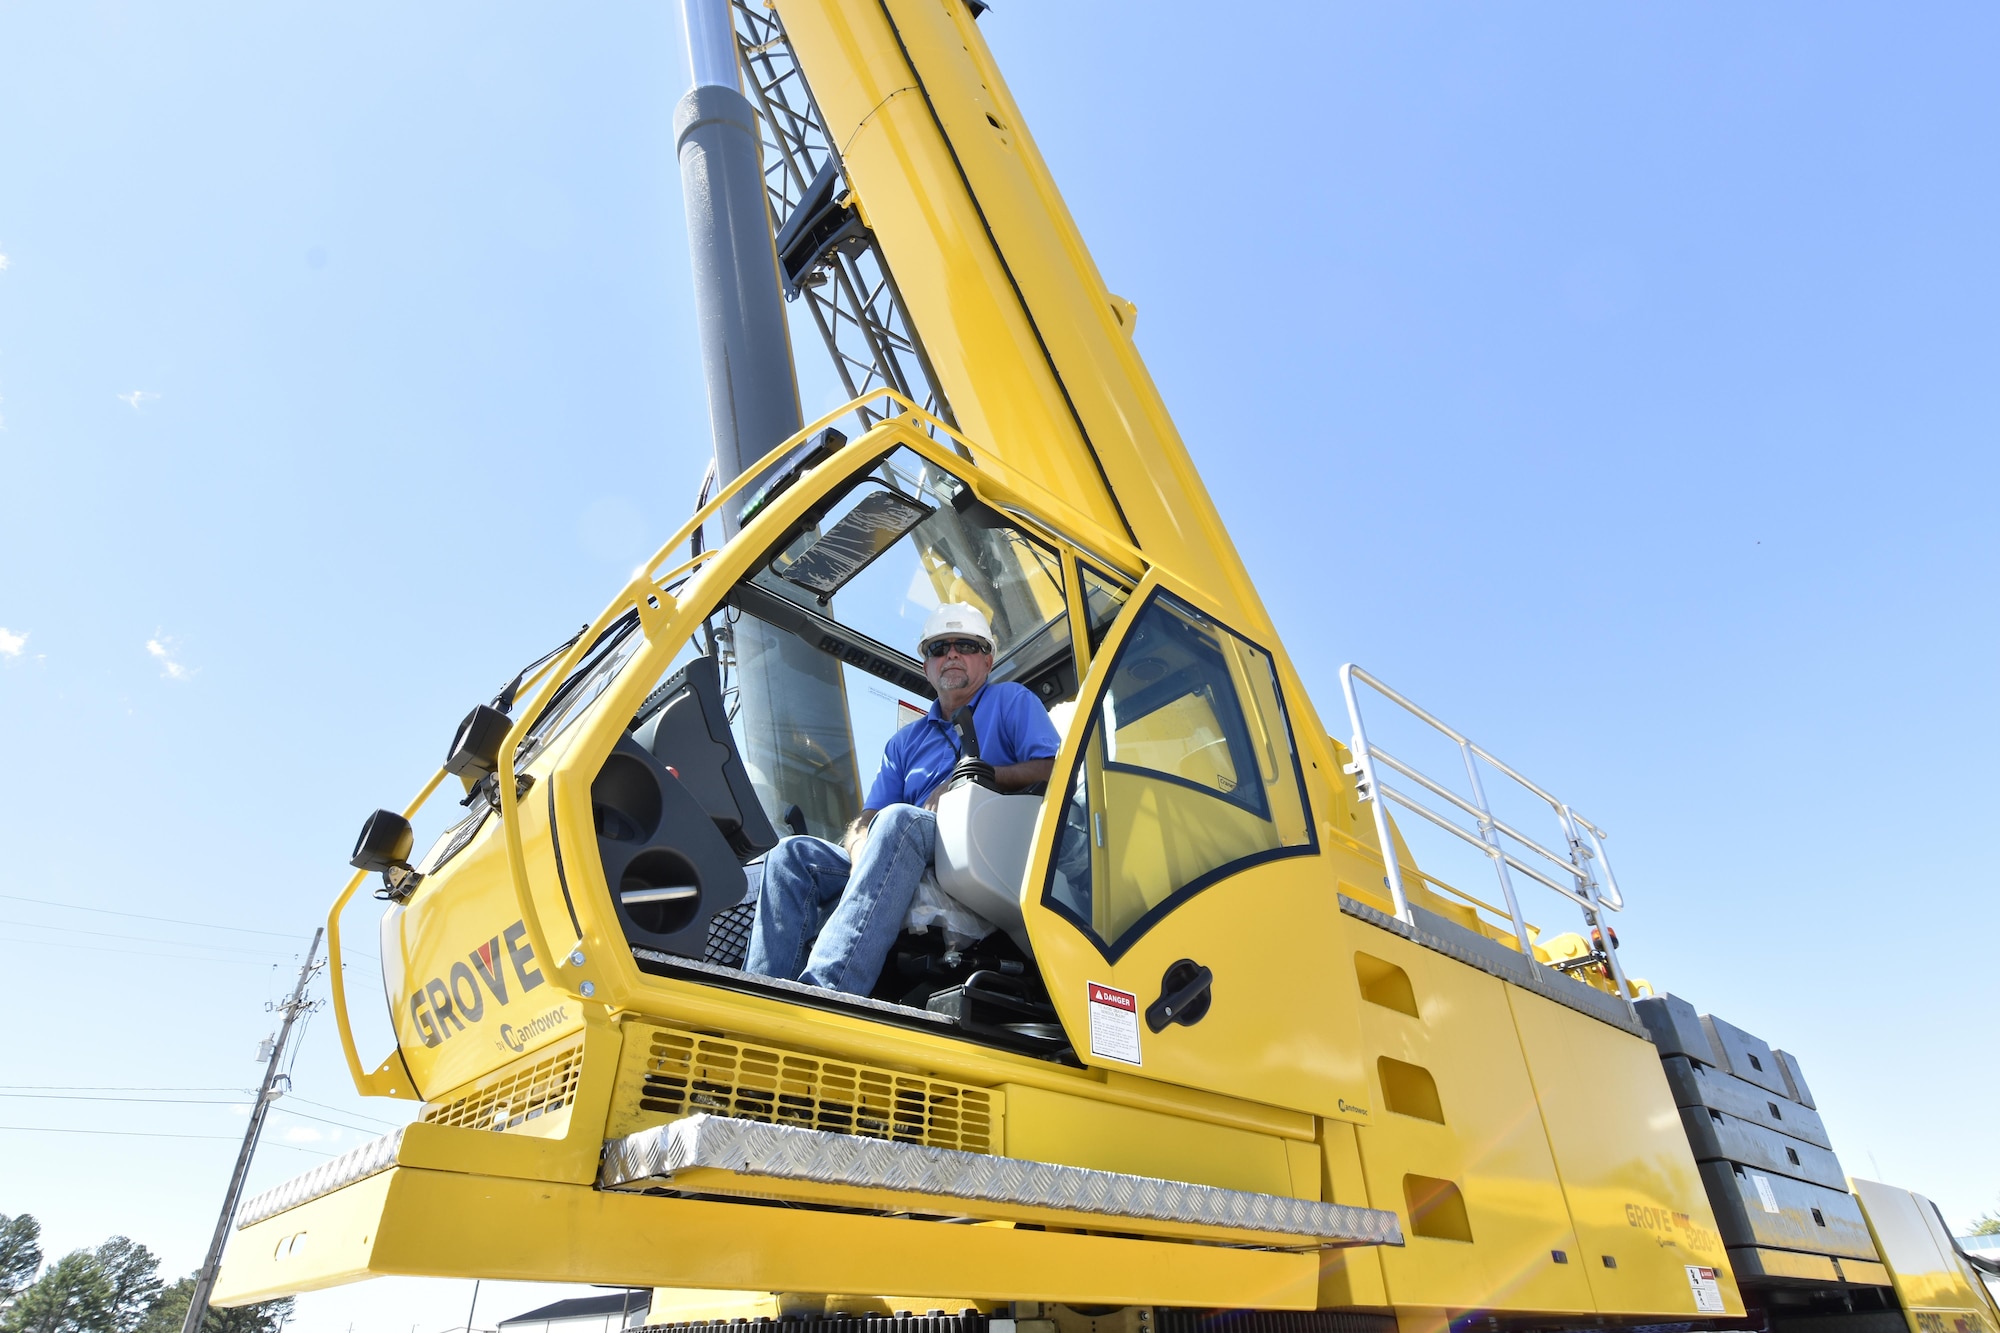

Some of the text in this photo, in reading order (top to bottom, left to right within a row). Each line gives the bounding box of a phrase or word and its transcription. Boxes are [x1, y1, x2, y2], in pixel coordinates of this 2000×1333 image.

[411, 919, 545, 1049] GROVE
[1103, 992, 1130, 1006] DANGER
[495, 1006, 569, 1053] by Manitowoc
[1625, 1203, 1672, 1232] GROVE
[1684, 1227, 1723, 1254] 5200-1
